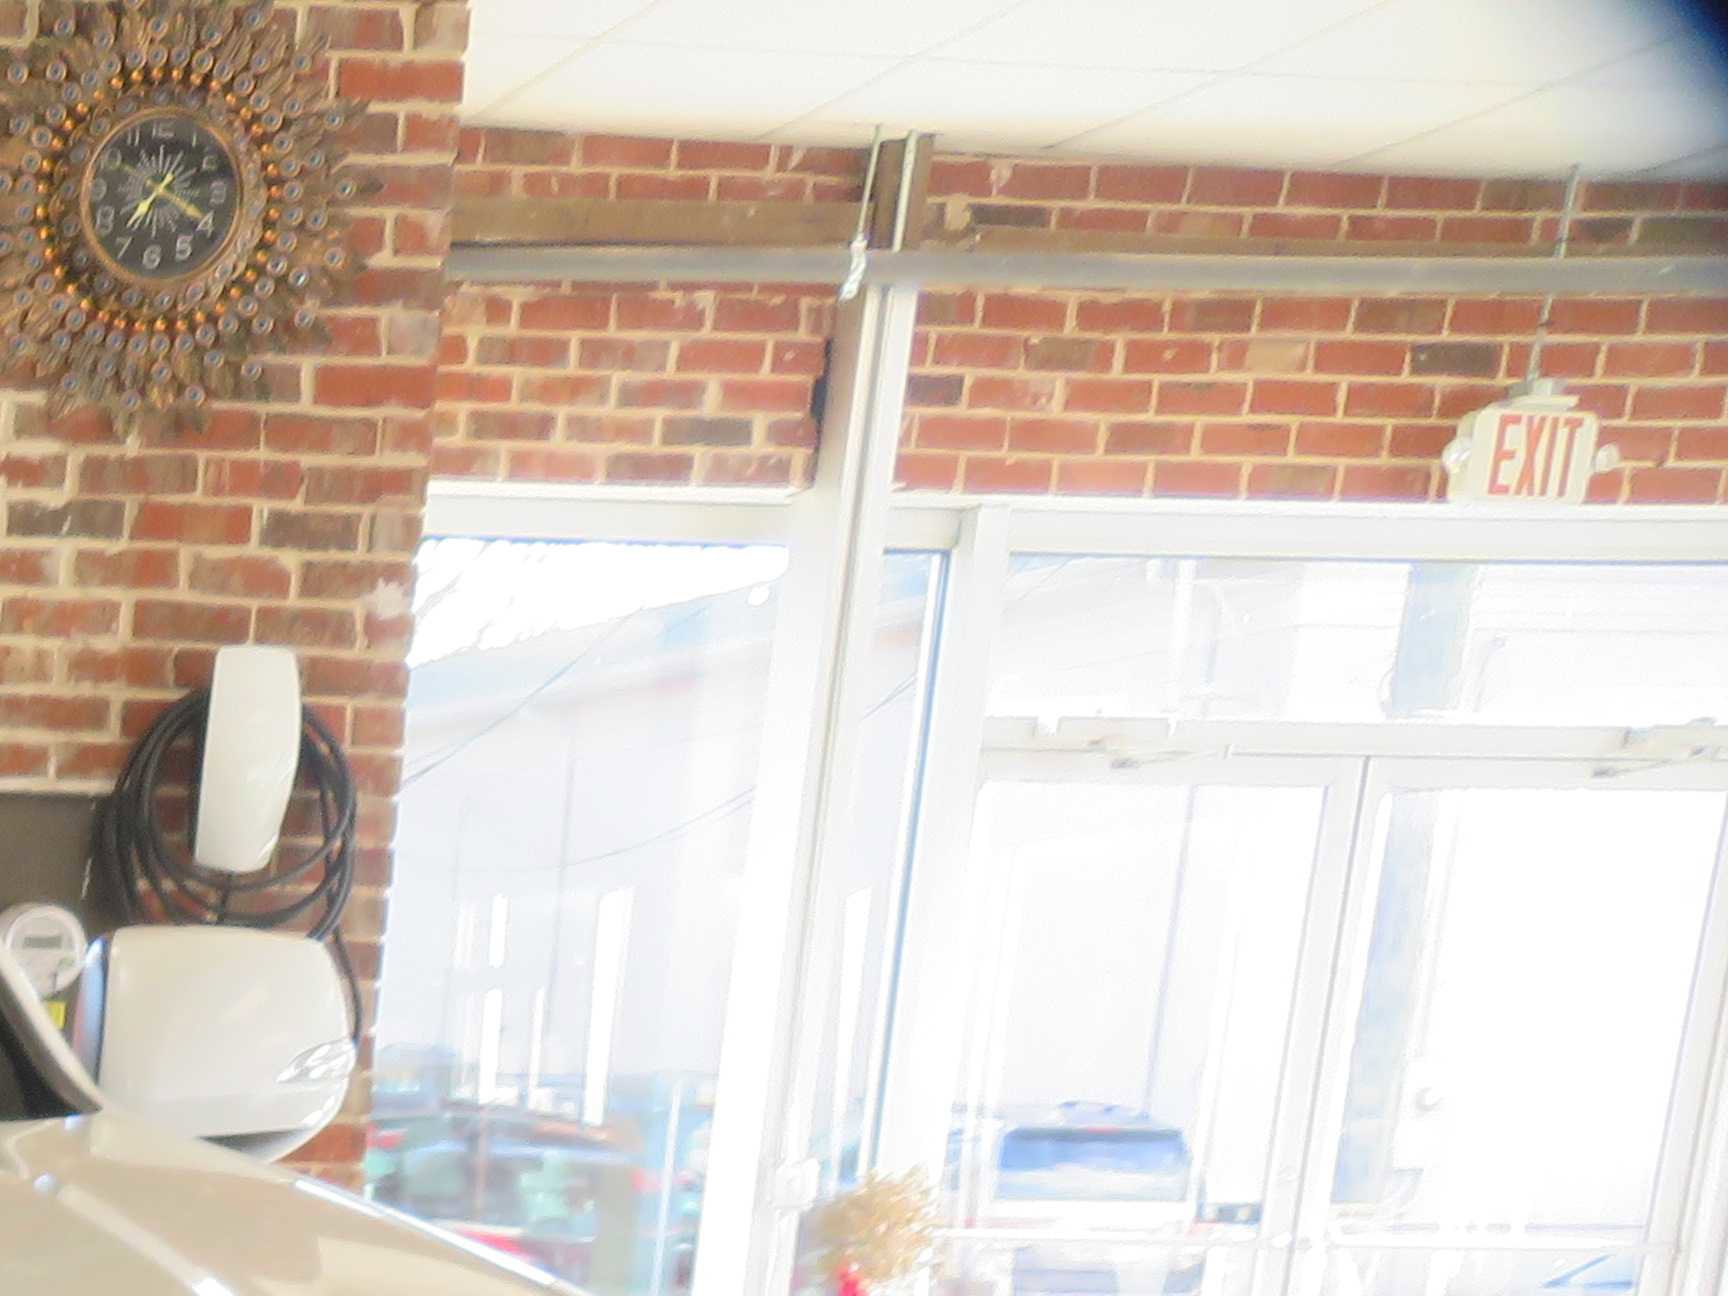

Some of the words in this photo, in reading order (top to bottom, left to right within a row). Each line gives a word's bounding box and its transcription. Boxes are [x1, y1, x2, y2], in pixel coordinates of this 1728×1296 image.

[127, 125, 141, 147] 11
[195, 209, 215, 238] 4
[115, 236, 133, 260] 7
[142, 244, 162, 270] 6
[176, 234, 194, 261] 5
[1487, 413, 1585, 497] EXIT
